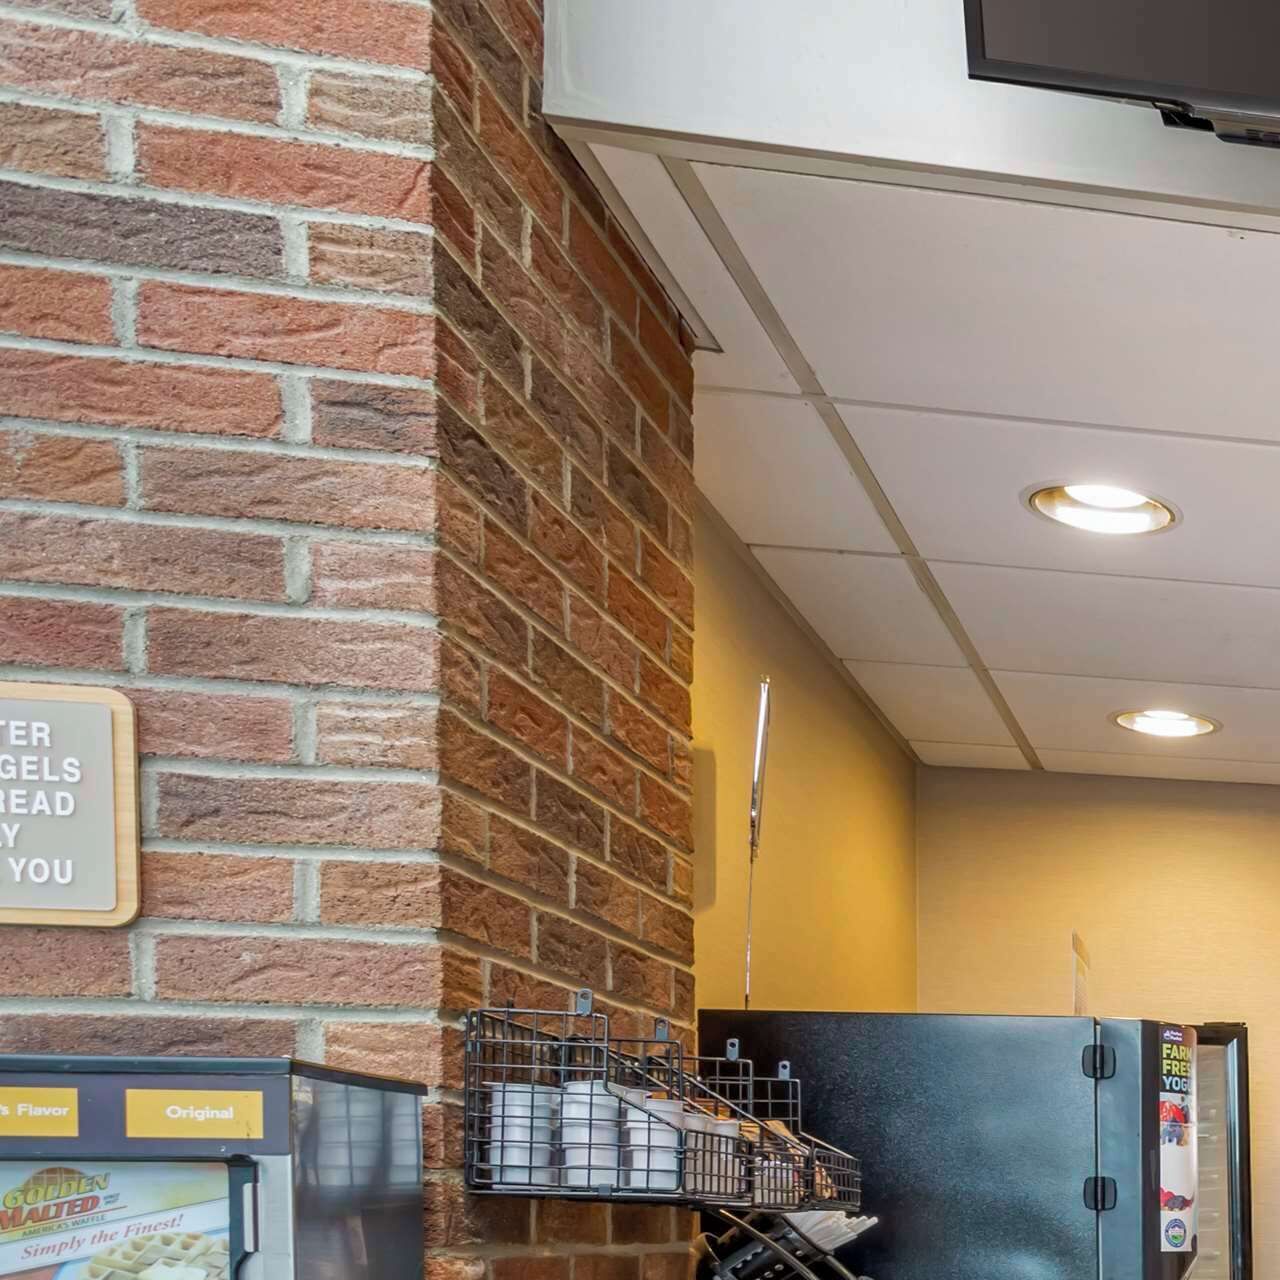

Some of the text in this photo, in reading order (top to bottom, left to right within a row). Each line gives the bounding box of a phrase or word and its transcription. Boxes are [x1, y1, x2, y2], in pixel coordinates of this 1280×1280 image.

[0, 720, 52, 748] ER
[0, 754, 82, 783] GELS
[8, 857, 74, 885] YOU
[16, 1103, 70, 1117] Flavor
[164, 1104, 234, 1121] Original
[3, 1171, 111, 1210] GOLDEN
[0, 1194, 101, 1231] MALTED
[20, 1213, 185, 1261] Simply the Finest!
